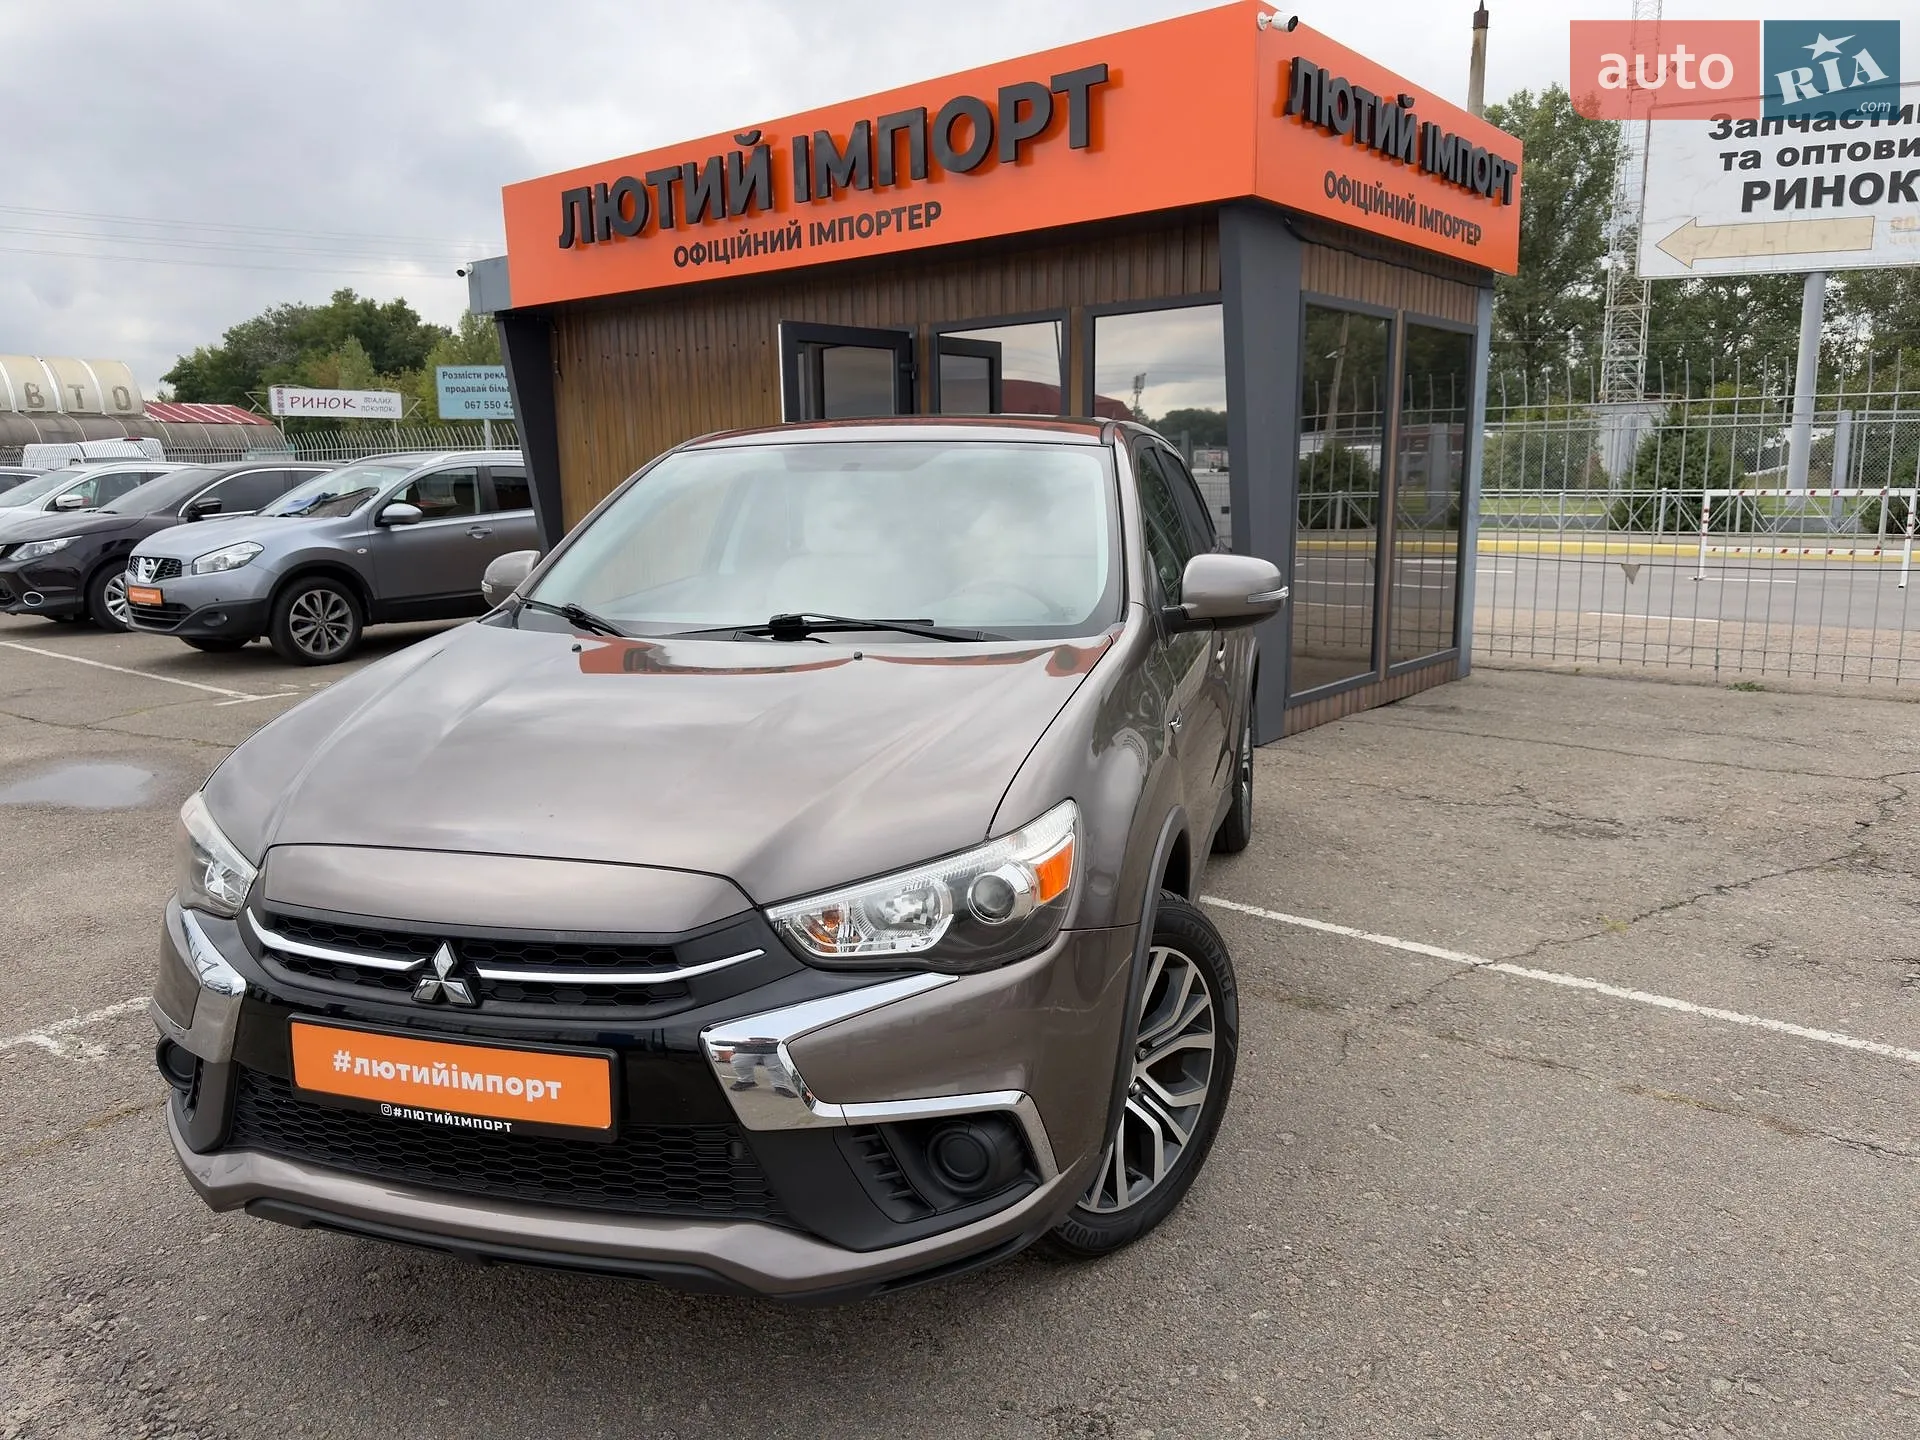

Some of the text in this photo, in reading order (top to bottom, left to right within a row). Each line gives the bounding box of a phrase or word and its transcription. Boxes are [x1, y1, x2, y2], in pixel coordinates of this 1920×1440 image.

[1285, 56, 1518, 206] ЛЮТИЙ ІМПОРТ
[1708, 103, 1920, 140] Запчасти
[558, 63, 1108, 249] ЛЮТИЙ ІМПОРТ
[1719, 150, 1762, 171] та
[1324, 170, 1482, 247] ОФІЦІЙНИЙ ІМПОРТЕР
[1741, 168, 1920, 213] РИНОК
[673, 200, 942, 268] ОФІЦІЙНИЙ ІМПОРТЕР
[442, 370, 507, 381] Розмісти рекл
[445, 384, 487, 395] продавай
[289, 396, 357, 409] РИНОК
[464, 400, 481, 410] 067
[484, 400, 501, 410] 550
[332, 1049, 562, 1102] #лютийімпорт
[393, 1106, 513, 1133] #ЛЮТИЙІМПОРТ
